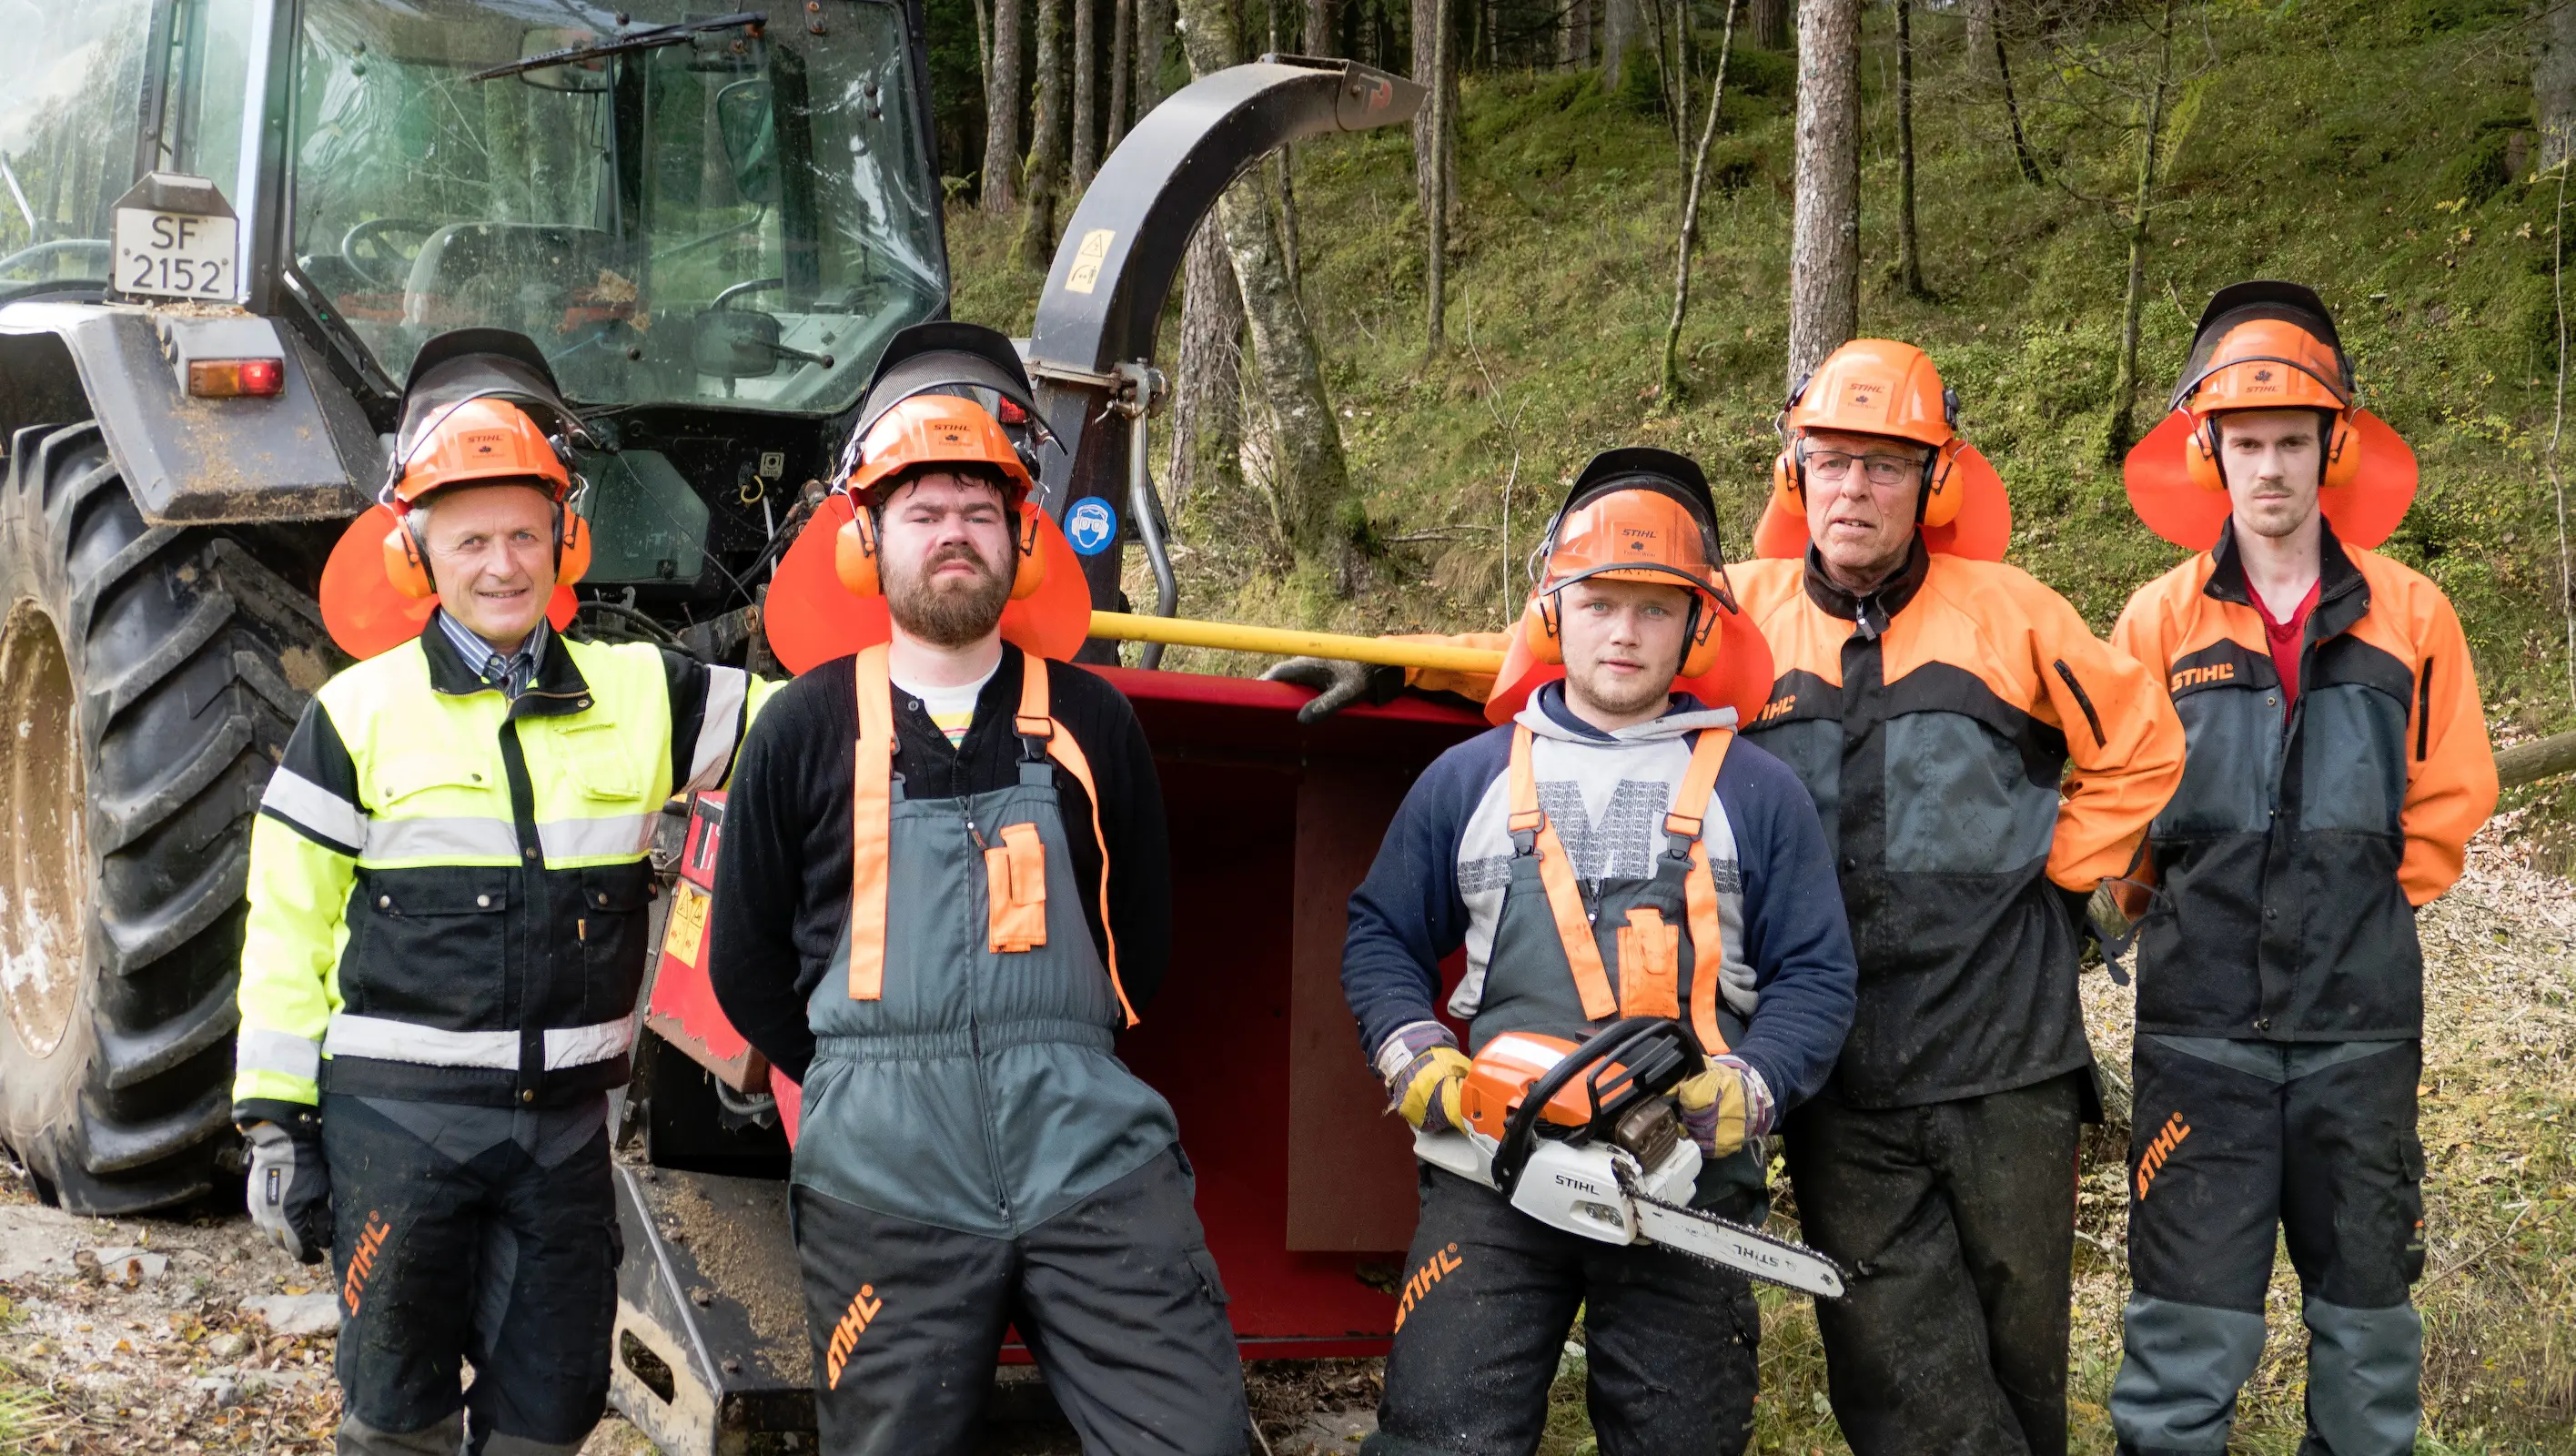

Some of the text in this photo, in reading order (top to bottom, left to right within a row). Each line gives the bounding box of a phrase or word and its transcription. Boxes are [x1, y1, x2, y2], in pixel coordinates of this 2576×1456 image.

[150, 215, 198, 250] SF
[132, 254, 220, 293] 2152
[1621, 529, 1656, 539] STIHL
[1555, 1174, 1601, 1197] STIHL
[1732, 1243, 1779, 1268] STIHL
